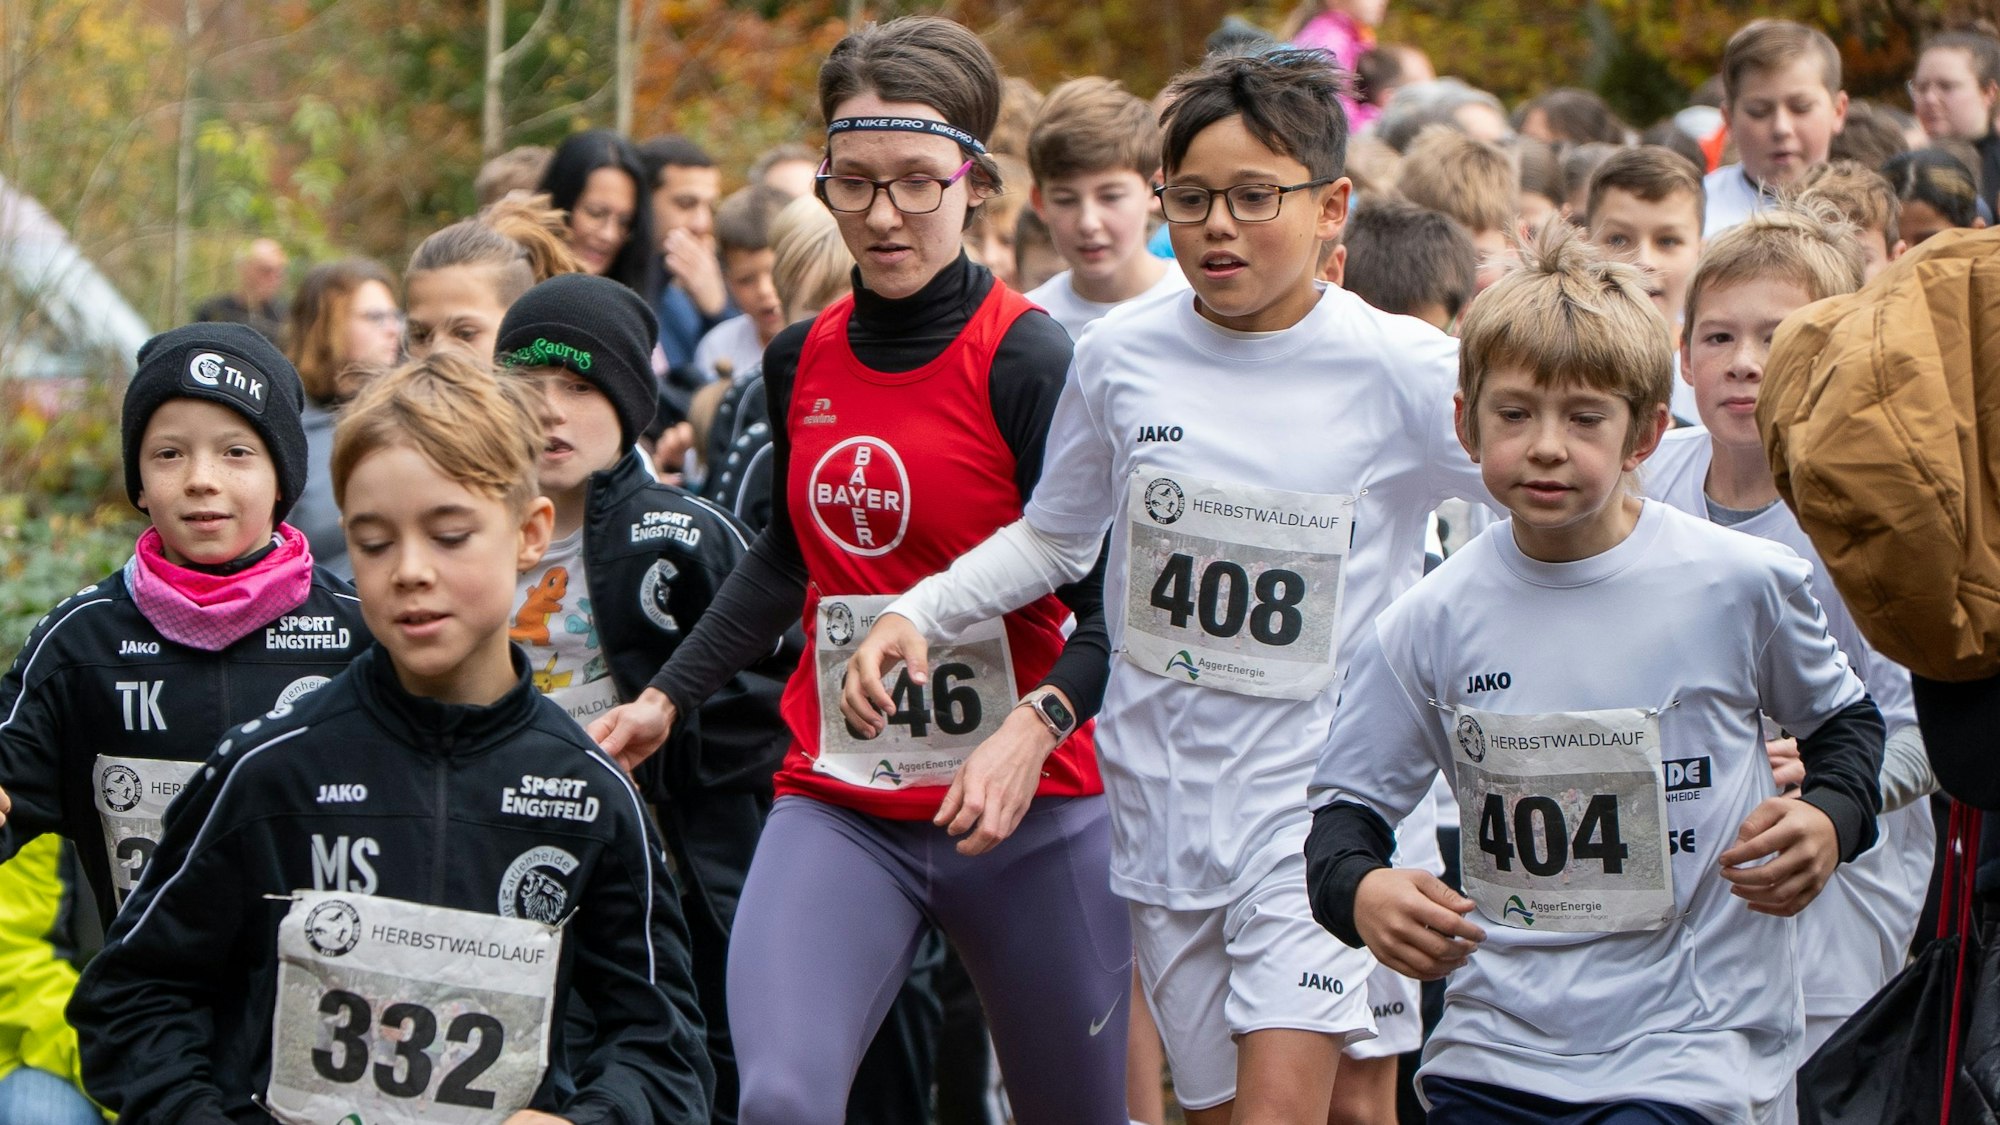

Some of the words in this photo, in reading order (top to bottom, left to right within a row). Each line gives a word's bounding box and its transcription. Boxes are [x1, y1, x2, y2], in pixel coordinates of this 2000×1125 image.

[855, 119, 888, 127] NIKE
[889, 119, 924, 128] PRO
[930, 123, 955, 136] NIKE
[954, 131, 972, 143] PRO
[224, 366, 246, 390] Th
[248, 378, 263, 400] K
[1137, 426, 1183, 443] JAKO
[817, 483, 901, 511] BAYER
[849, 446, 875, 546] BAYER
[642, 511, 693, 527] SPORT
[1193, 499, 1339, 529] HERBSTWALDLAUF
[631, 523, 701, 547] ENGSTFELD
[1151, 553, 1305, 646] 408
[280, 616, 334, 631] SPORT
[119, 640, 160, 654] JAKO
[266, 628, 350, 649] ENGSTFELD
[1197, 657, 1265, 678] AggerEnergie
[1467, 672, 1512, 694] JAKO
[115, 680, 167, 730] TK
[841, 662, 982, 740] 46
[1490, 731, 1644, 750] HERBSTWALDLAUF
[898, 758, 962, 773] AggerEnergie
[1663, 760, 1700, 787] DE
[316, 784, 368, 803] JAKO
[521, 775, 587, 799] SPORT
[501, 788, 599, 823] ENGSTFELD
[1479, 793, 1628, 877] 404
[311, 834, 380, 896] MS
[1530, 900, 1602, 912] AggerEnergie
[371, 925, 545, 964] HERBSTWALDLAUF
[1298, 972, 1344, 995] JAKO
[1372, 1002, 1404, 1018] AKO
[311, 989, 503, 1109] 332
